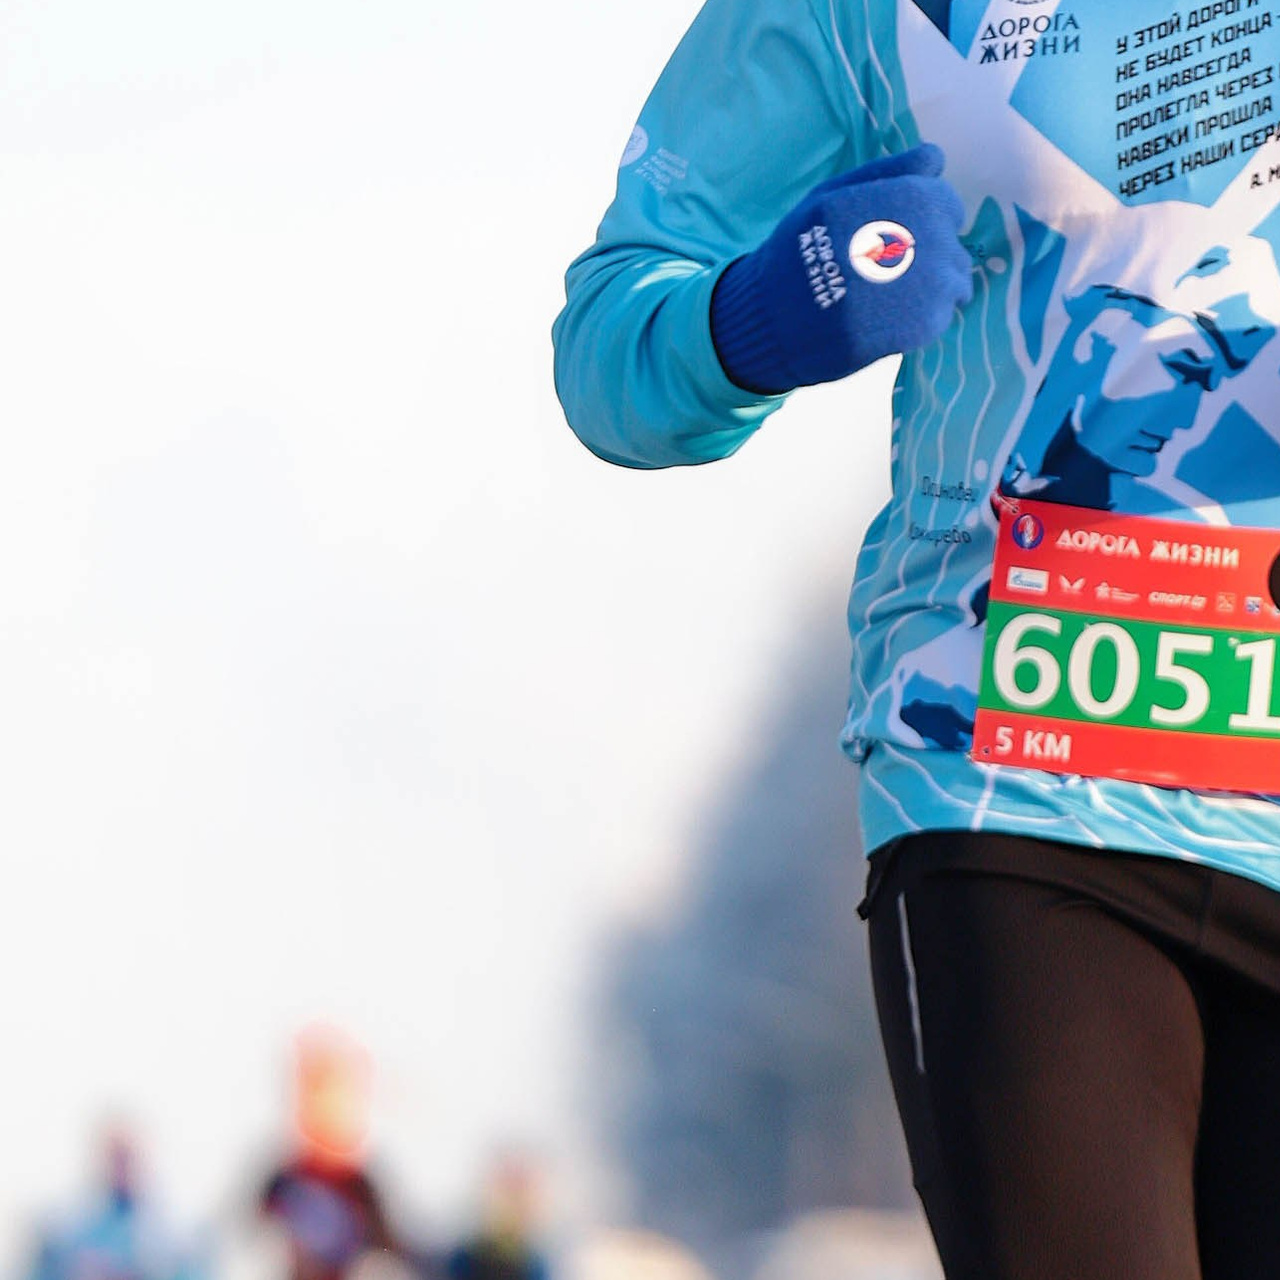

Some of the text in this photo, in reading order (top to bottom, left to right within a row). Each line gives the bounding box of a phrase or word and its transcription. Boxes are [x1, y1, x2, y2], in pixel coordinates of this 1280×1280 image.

[979, 35, 1081, 65] ЖИЗНИ
[980, 13, 1081, 41] ДОРОГА
[1116, 37, 1127, 55] У
[1133, 13, 1180, 49] ЭТОЙ
[1116, 60, 1140, 83] НЕ
[1145, 36, 1206, 70] БУДЕТ
[1211, 11, 1273, 48] КОНЦА
[1115, 47, 1252, 111] ОНА НАВСЕГДА
[1115, 91, 1210, 141] ПРОЛЕГЛА
[1215, 67, 1274, 102] ЧЕРЕЗ
[1117, 95, 1273, 170] НАВЕКИ ПРОШЛА
[1119, 161, 1176, 198] ЧЕРЕЗ
[1181, 141, 1235, 174] НАШИ
[1055, 528, 1241, 568] ДОРОГА ЖИЗНИ
[995, 725, 1072, 762] 5 КМ
